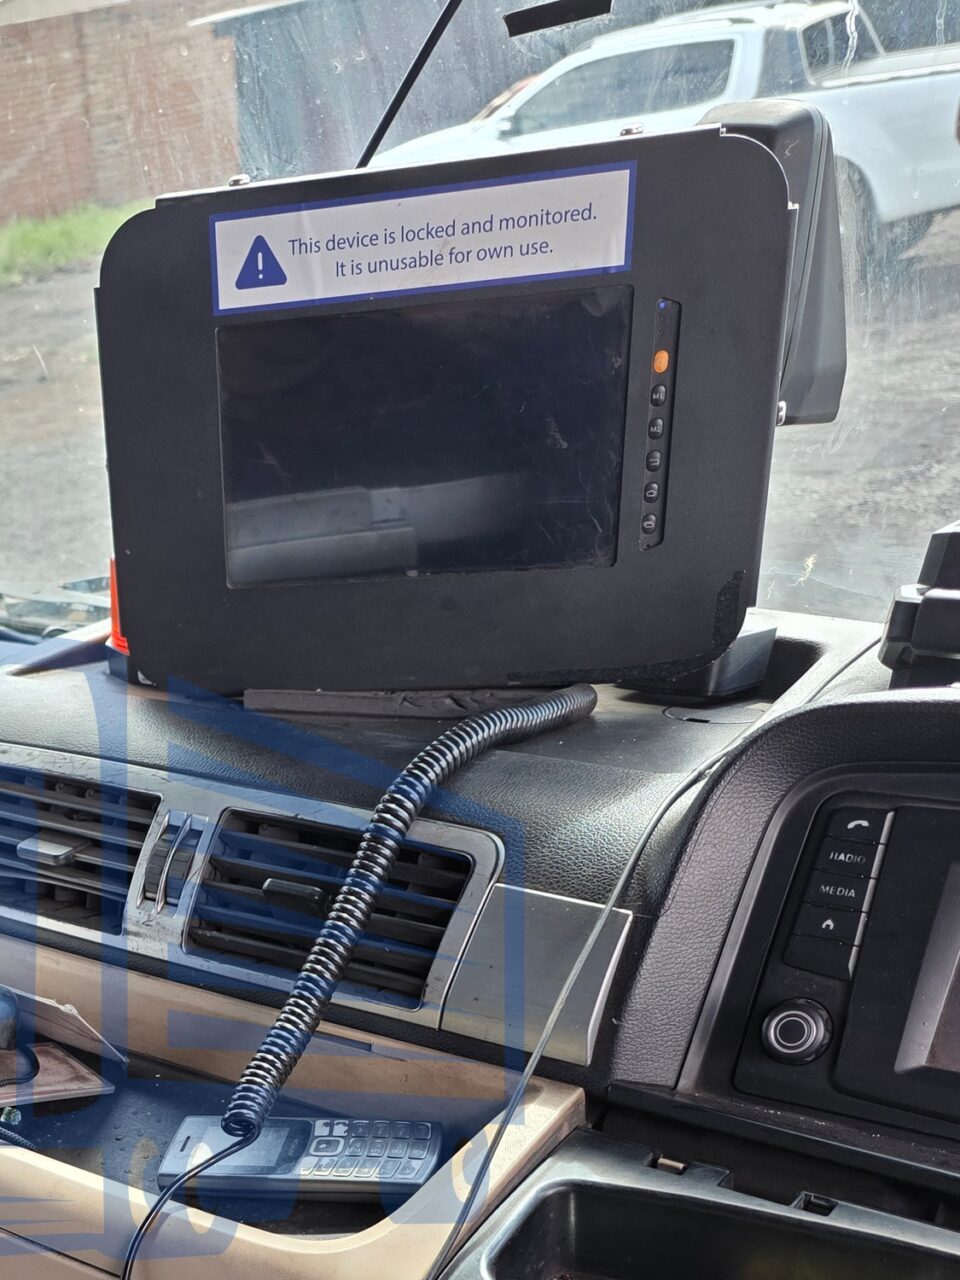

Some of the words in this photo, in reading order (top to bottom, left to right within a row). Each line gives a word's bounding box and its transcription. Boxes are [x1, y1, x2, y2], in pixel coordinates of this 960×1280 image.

[288, 236, 321, 256] This
[325, 230, 379, 252] device
[383, 227, 396, 246] is
[400, 218, 456, 244] locked
[461, 214, 495, 237] and
[499, 202, 597, 233] monitored.
[335, 259, 346, 278] It
[350, 257, 363, 276] is
[367, 248, 444, 275] unusable
[448, 245, 473, 265] for
[476, 244, 514, 261] own
[518, 239, 554, 257] use.
[829, 851, 866, 864] RADIO
[819, 884, 856, 898] MEDIA
